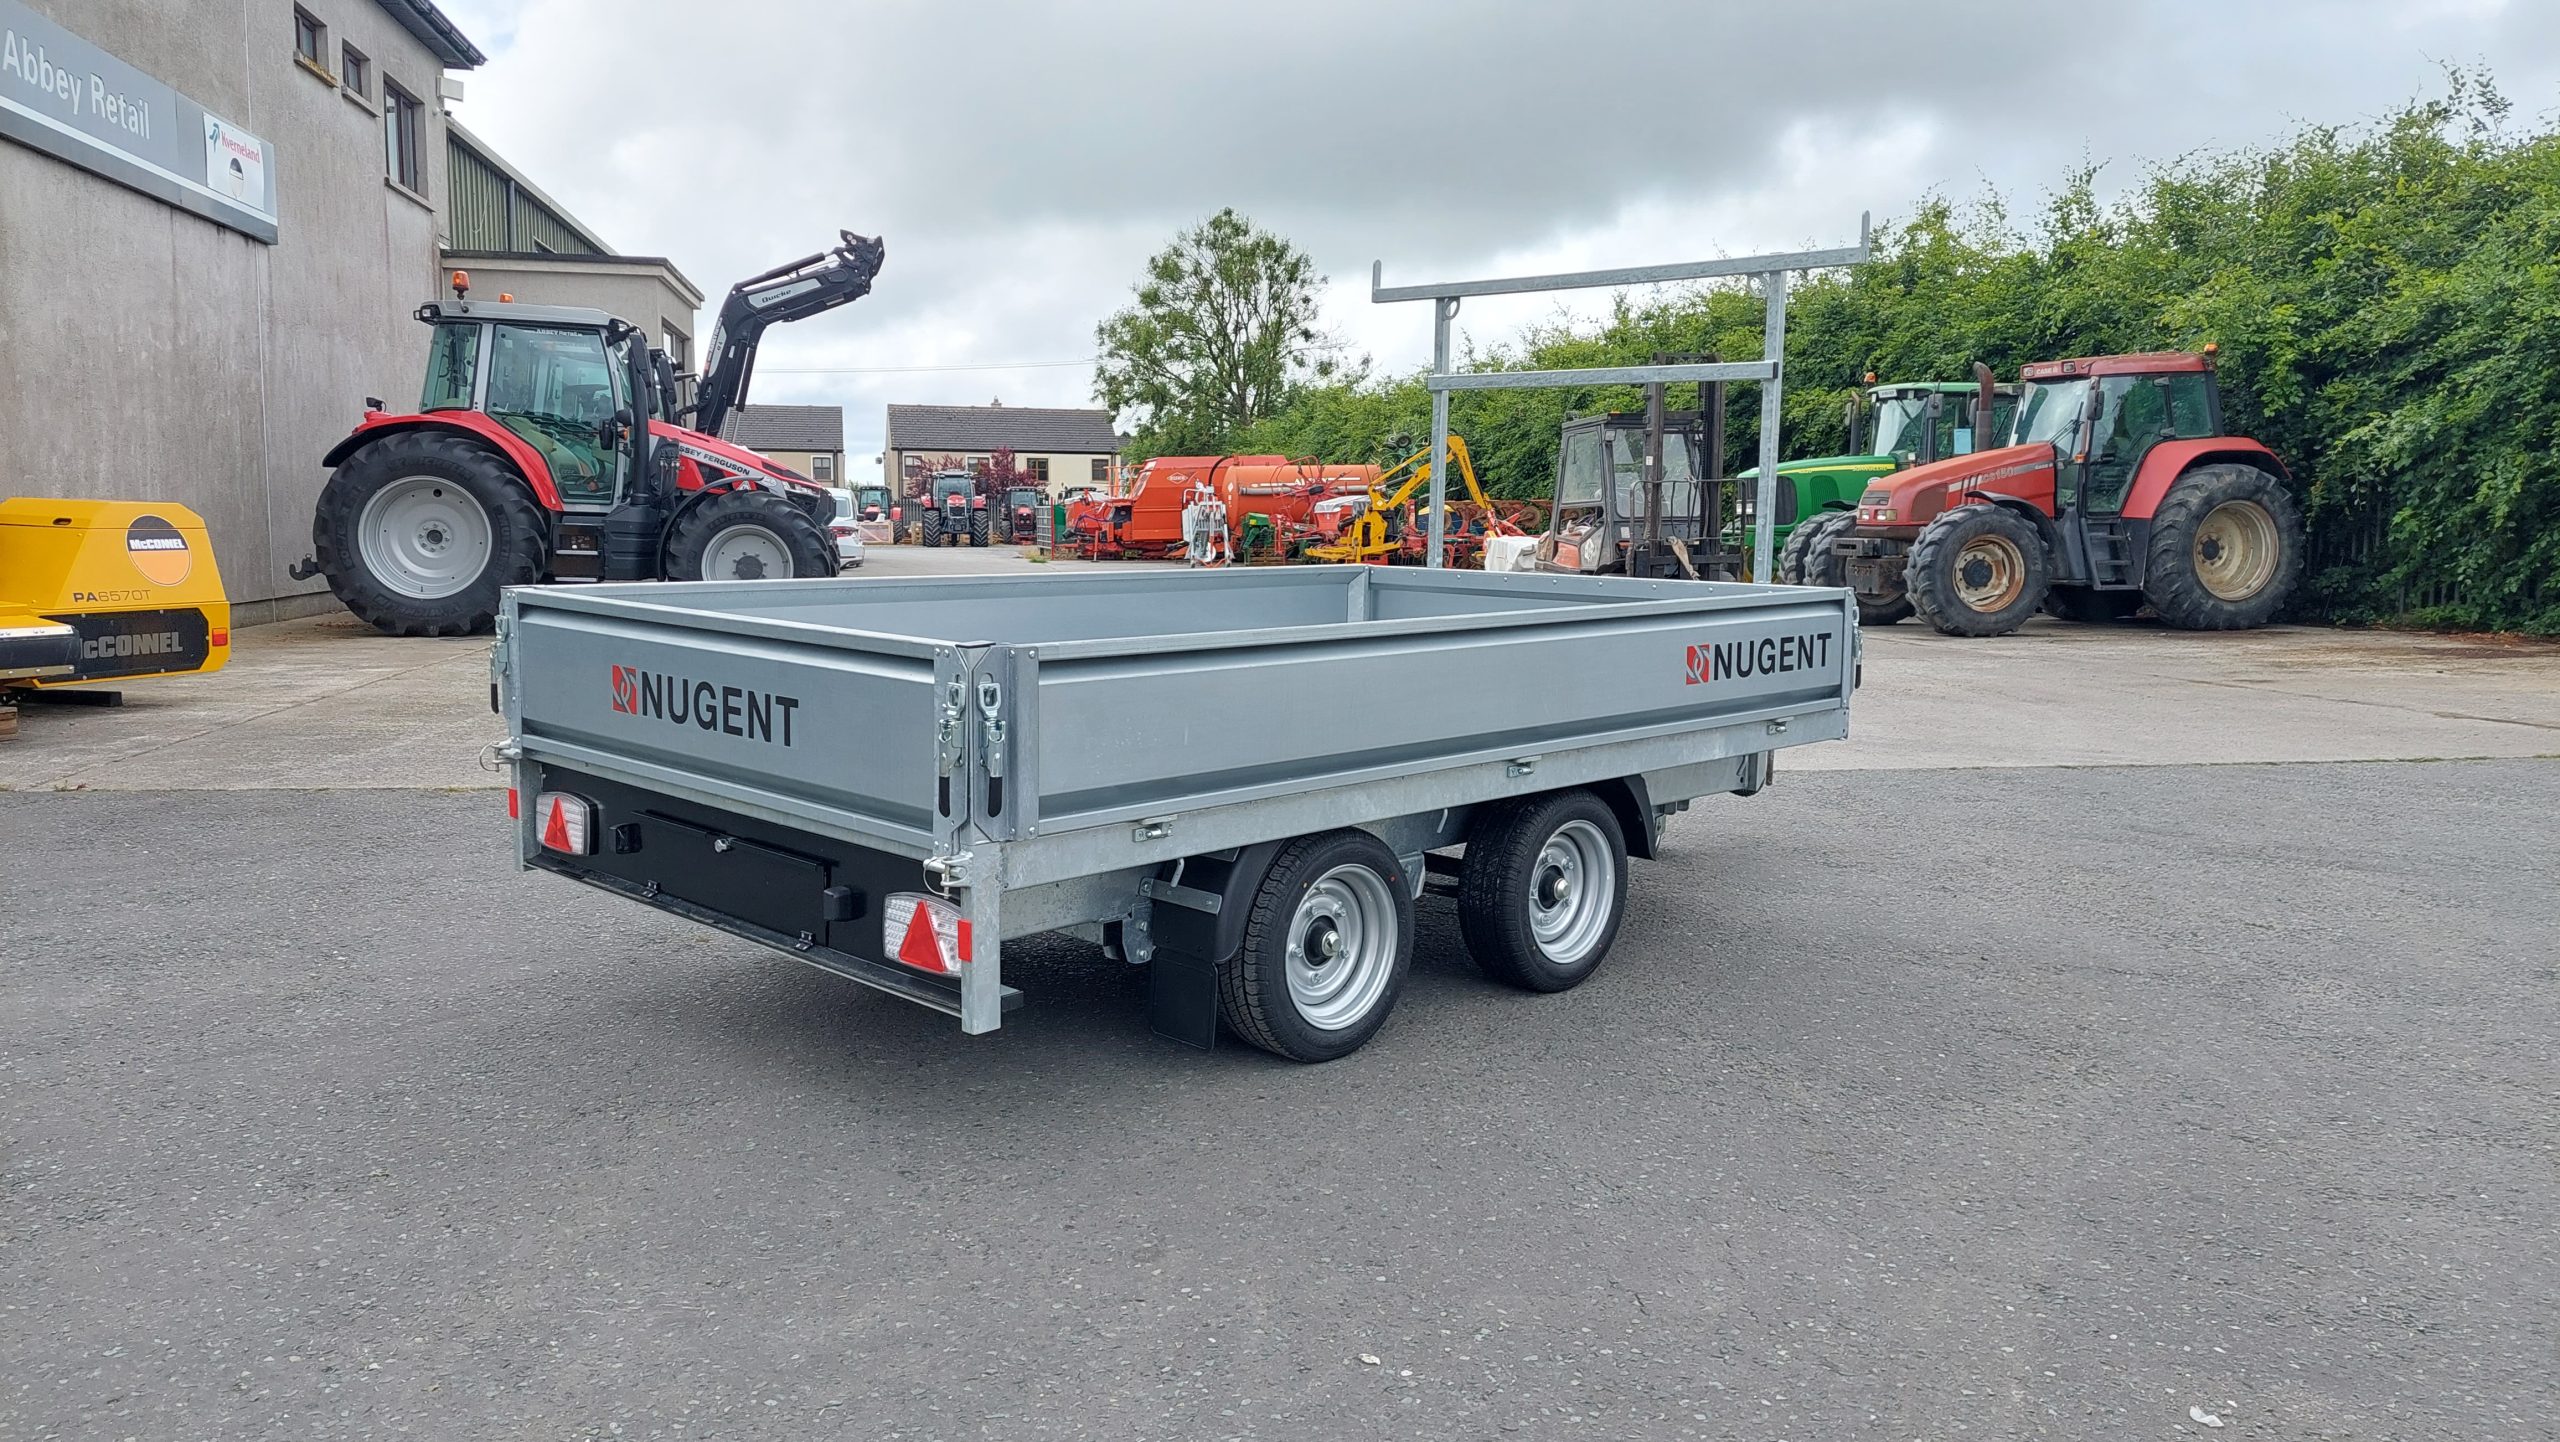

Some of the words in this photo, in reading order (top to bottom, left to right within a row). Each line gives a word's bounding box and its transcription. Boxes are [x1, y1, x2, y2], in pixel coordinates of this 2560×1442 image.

[3, 28, 82, 115] Abbey
[90, 73, 150, 140] Retail
[221, 131, 260, 163] Kverneland
[679, 445, 702, 457] SSEY
[703, 453, 750, 476] FERGUSON
[129, 538, 186, 550] McCONNEL
[73, 589, 151, 603] PA6570T
[80, 631, 184, 660] cCONNEL
[1713, 632, 1832, 681] NUGENT
[641, 671, 799, 747] NUGENT
